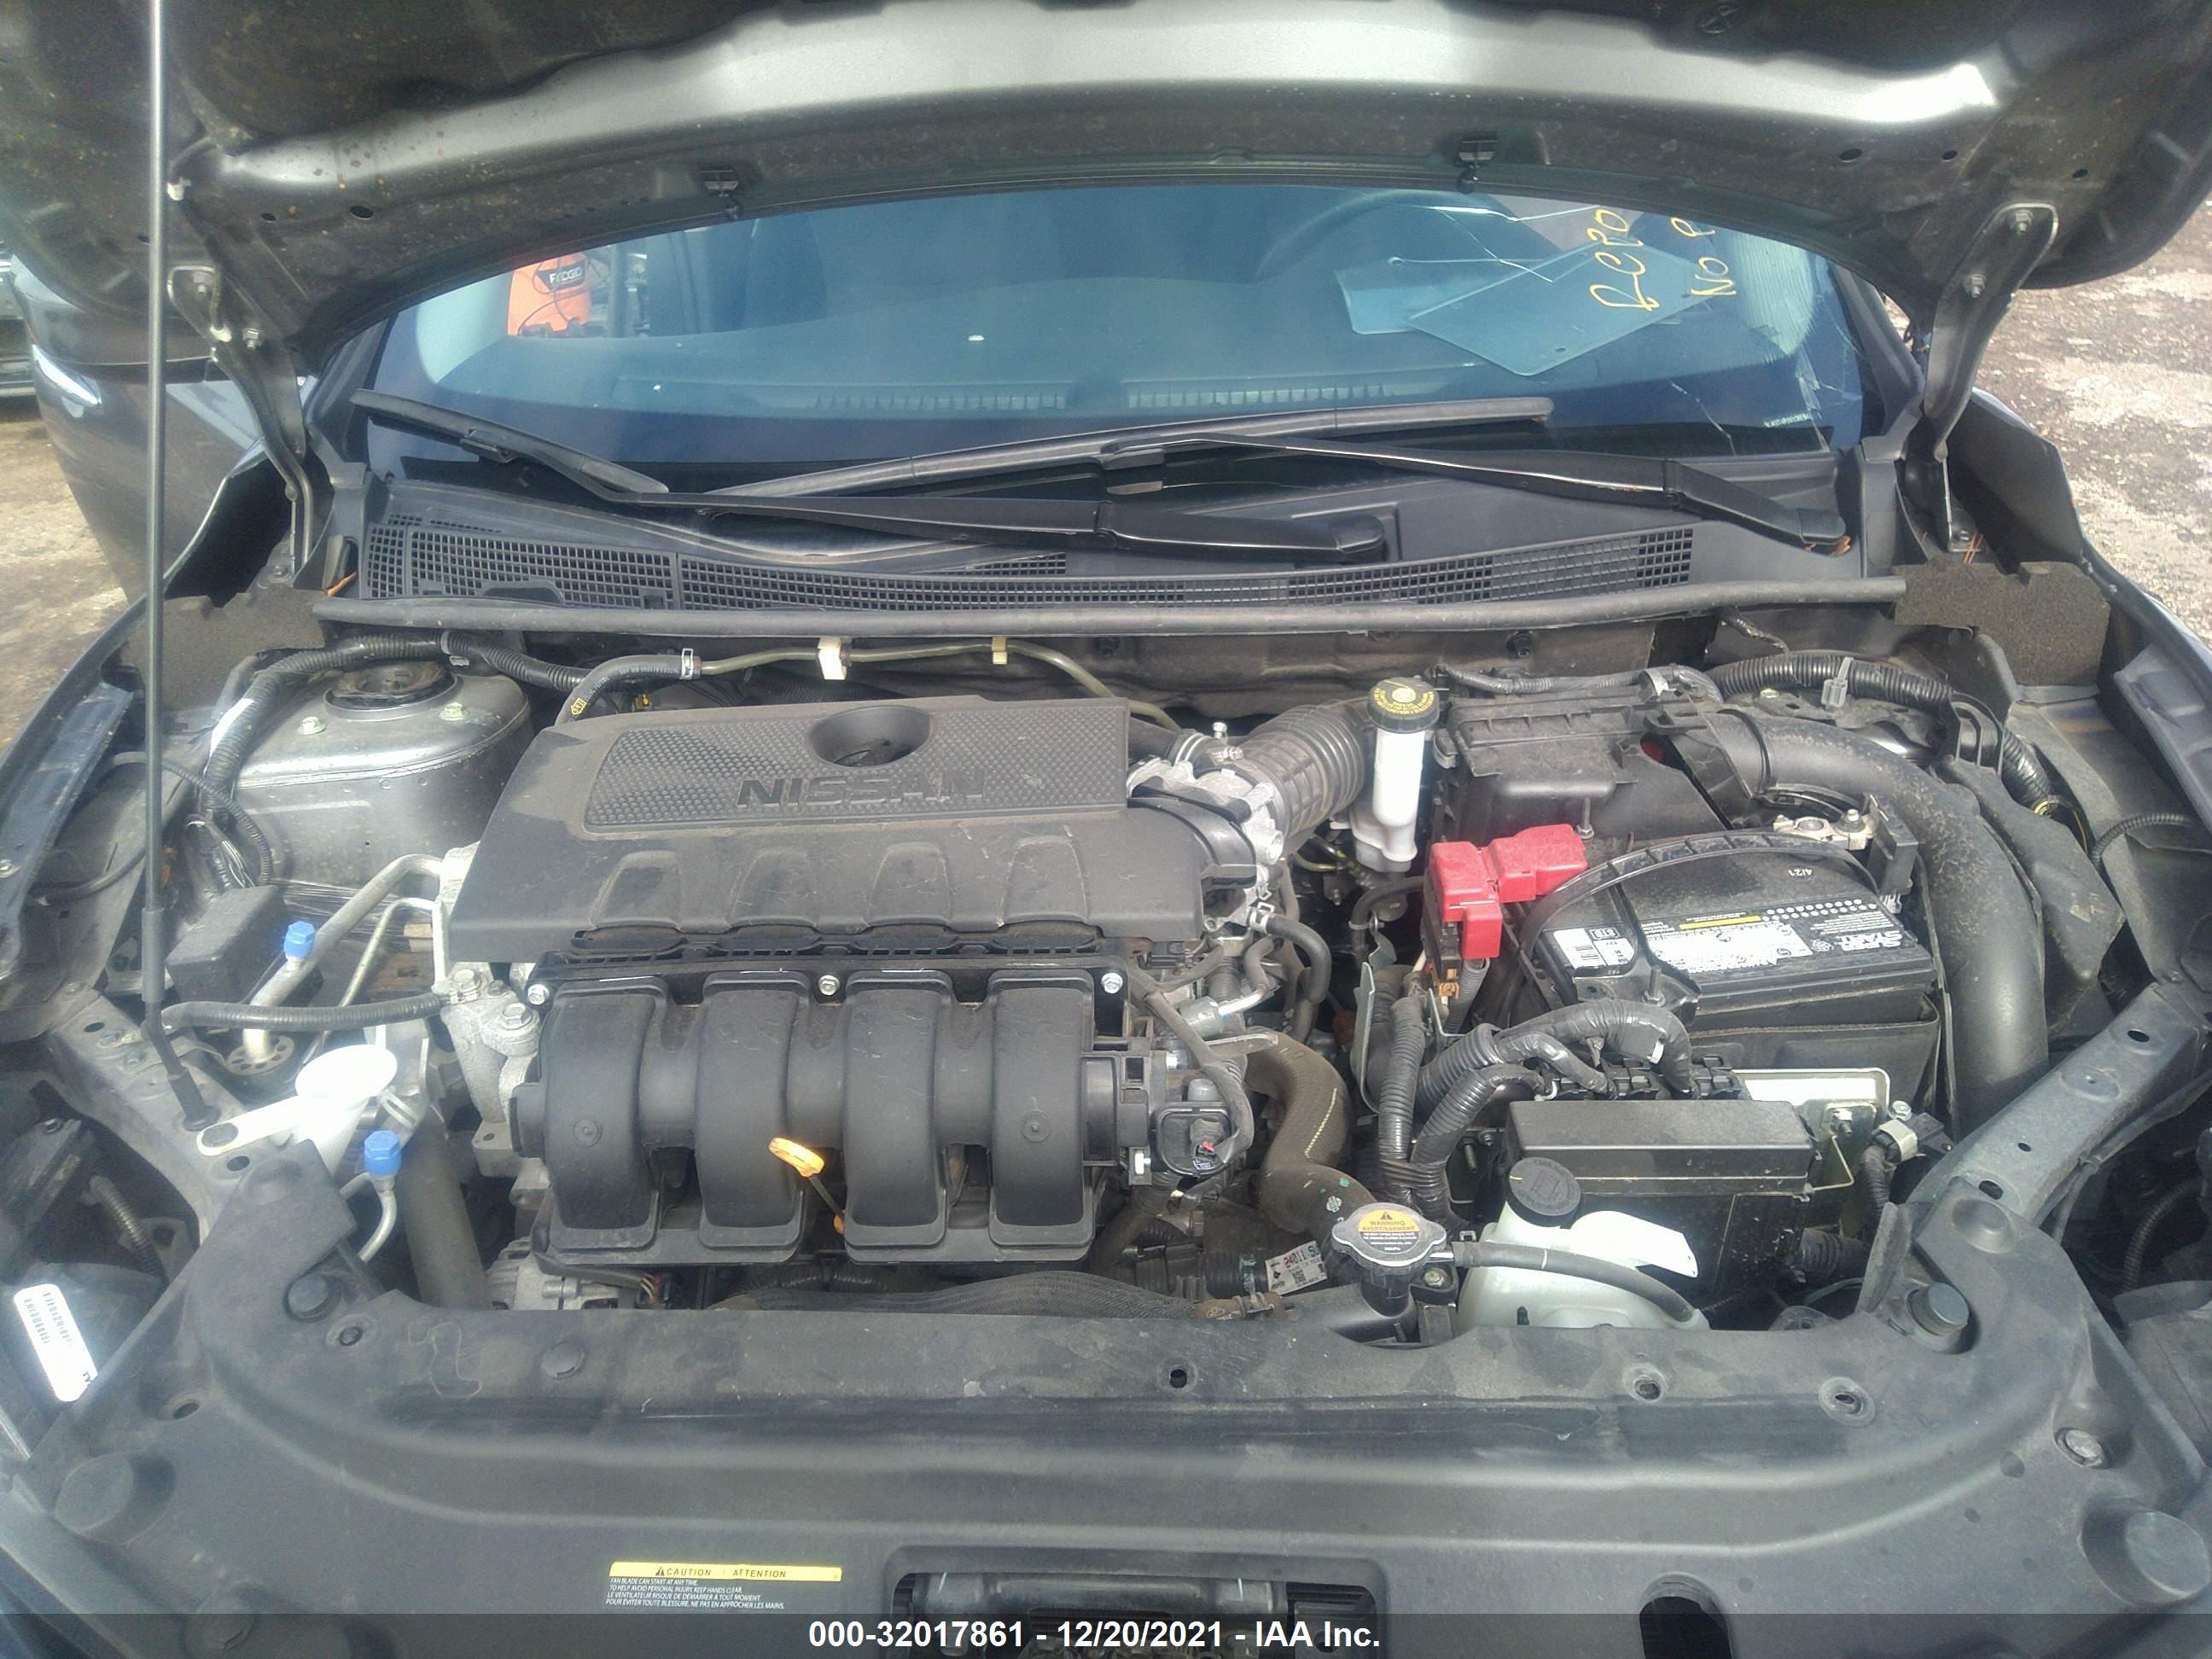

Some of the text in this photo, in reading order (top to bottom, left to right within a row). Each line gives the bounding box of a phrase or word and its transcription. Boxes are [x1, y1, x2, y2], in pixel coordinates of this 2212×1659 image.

[1690, 256, 1738, 297] NO
[736, 771, 982, 808] NISSAN
[732, 1569, 786, 1578] ATTENTION
